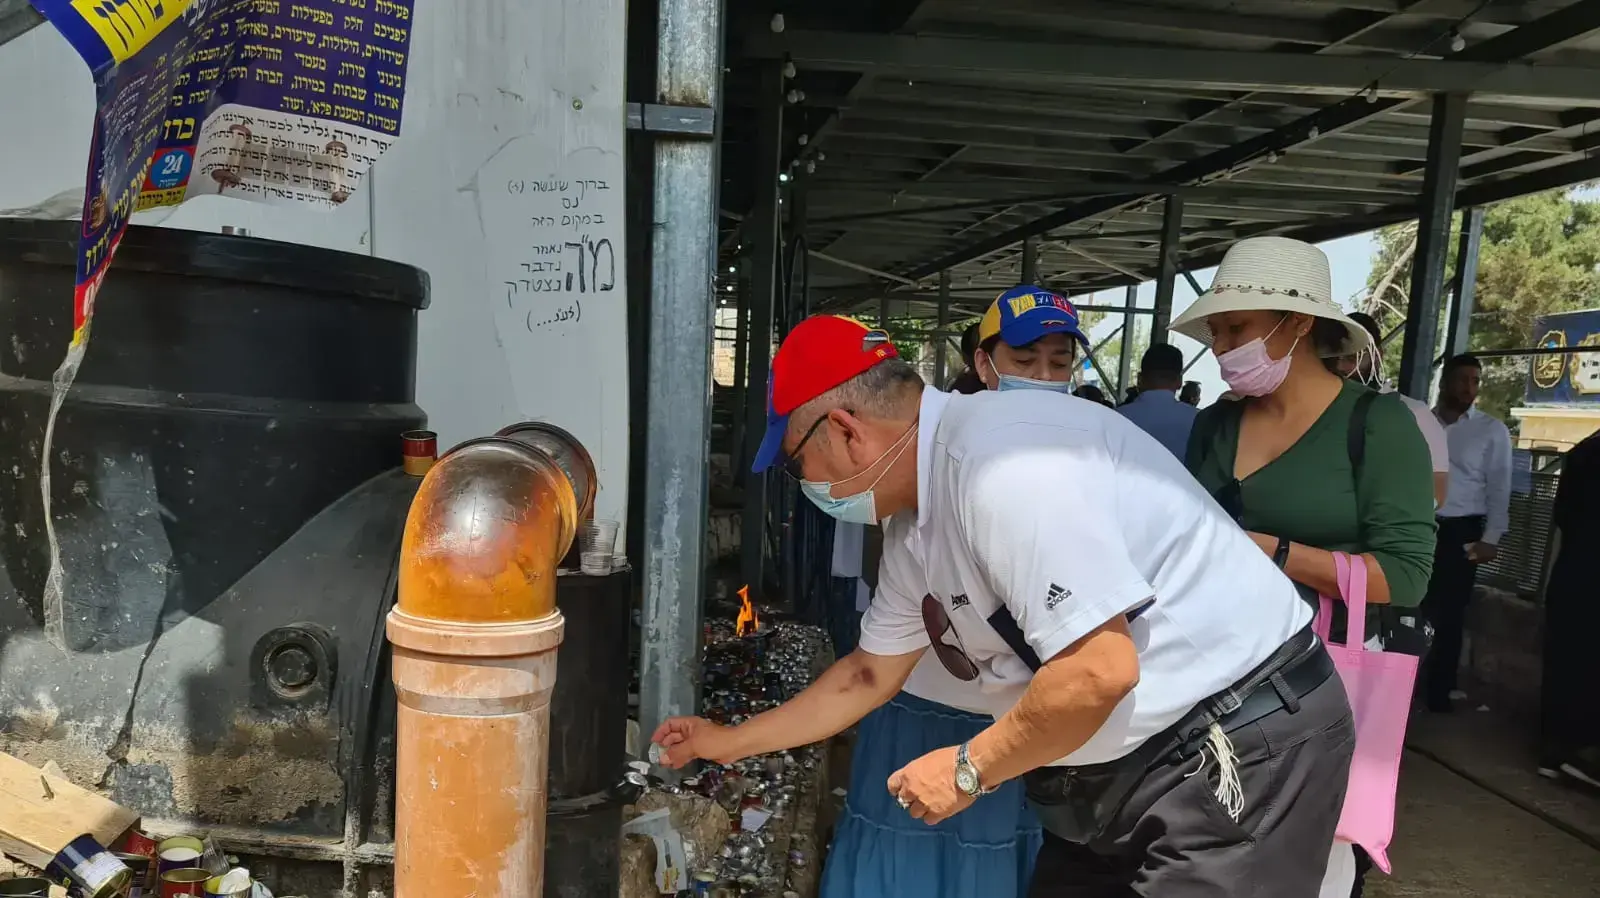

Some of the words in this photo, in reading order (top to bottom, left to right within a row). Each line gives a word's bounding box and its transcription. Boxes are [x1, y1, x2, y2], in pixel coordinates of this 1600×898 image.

[290, 5, 334, 26] מפעילות
[343, 16, 364, 32] חלק
[271, 25, 316, 45] שיעורים,
[373, 22, 407, 43] לפניכם
[318, 34, 360, 54] הילולות,
[294, 52, 326, 71] מעמדי
[361, 44, 404, 65] שידורים,
[256, 68, 283, 84] חברת
[338, 61, 366, 78] מירון,
[377, 70, 402, 88] ניגוני
[332, 82, 367, 101] שבתות
[374, 92, 399, 110] ארגון
[367, 112, 397, 131] עמדות
[162, 153, 184, 175] 24
[533, 180, 569, 192] שעשה
[576, 180, 610, 200] ברוך
[562, 197, 579, 209] נס
[532, 216, 555, 227] הזה
[561, 214, 605, 231] במקום
[533, 244, 562, 255] נאמר
[520, 260, 562, 273] נדבר
[504, 278, 562, 309] נצטדק
[1046, 589, 1073, 611] adidas
